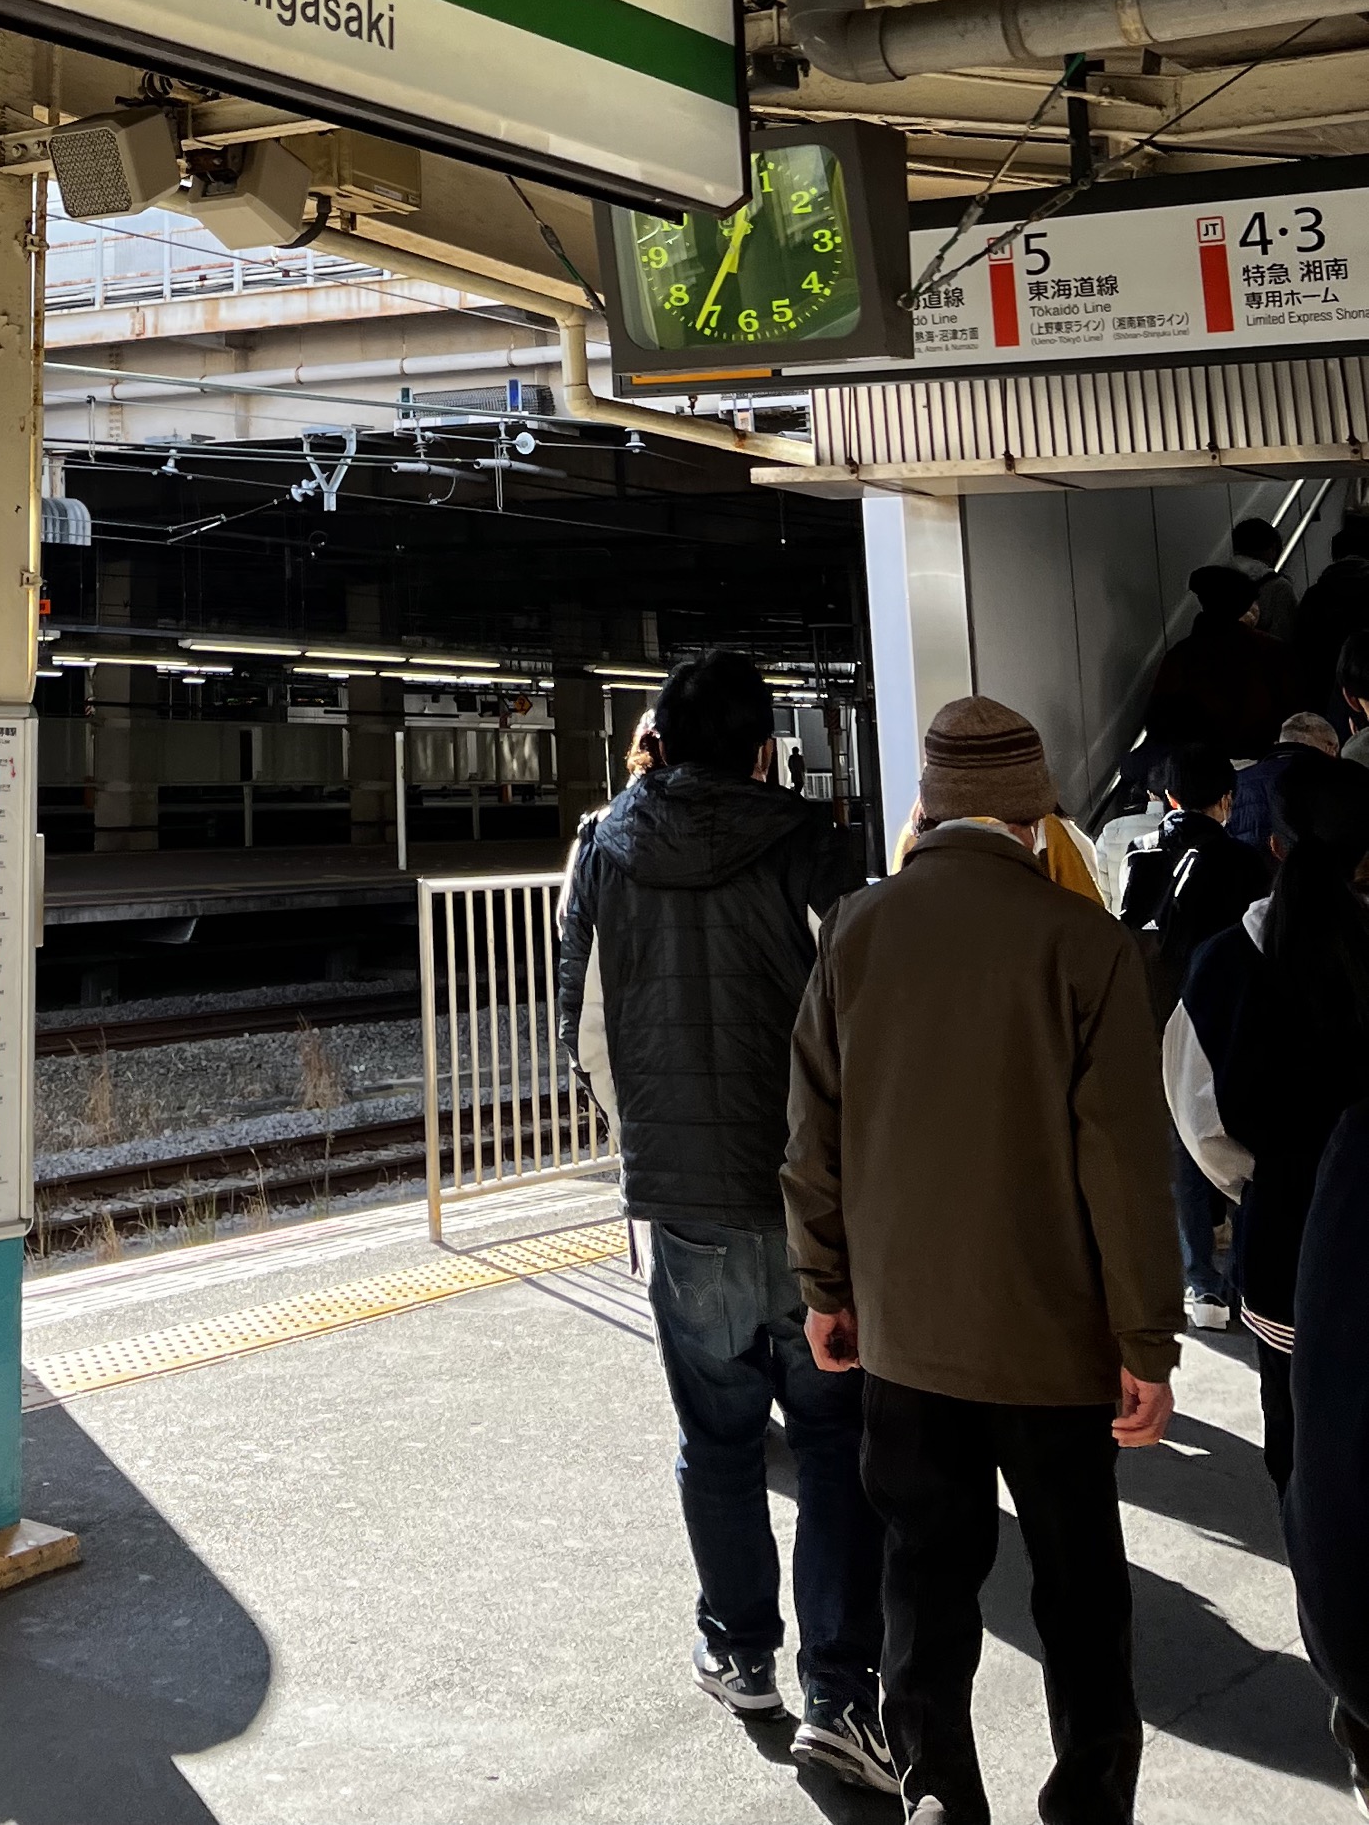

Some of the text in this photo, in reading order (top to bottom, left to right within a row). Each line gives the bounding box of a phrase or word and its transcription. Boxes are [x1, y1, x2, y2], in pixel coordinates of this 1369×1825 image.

[759, 170, 774, 193] 1
[790, 191, 812, 214] 2
[813, 229, 834, 252] 3
[1202, 223, 1219, 237] JT
[647, 246, 669, 269] 9
[1023, 232, 1051, 276] 5
[801, 271, 824, 294] 4
[1241, 257, 1349, 287] 特急 湘南
[669, 284, 690, 307] 8
[1027, 273, 1120, 302] 東海道線
[1244, 287, 1340, 310] 専用ホーム
[708, 305, 723, 327] 7
[738, 309, 759, 333] 6
[771, 298, 793, 323] 5
[932, 313, 958, 325] Line
[1029, 301, 1112, 318] Tōkaidō Line
[1246, 312, 1286, 327] Limited
[1288, 310, 1333, 325] Express
